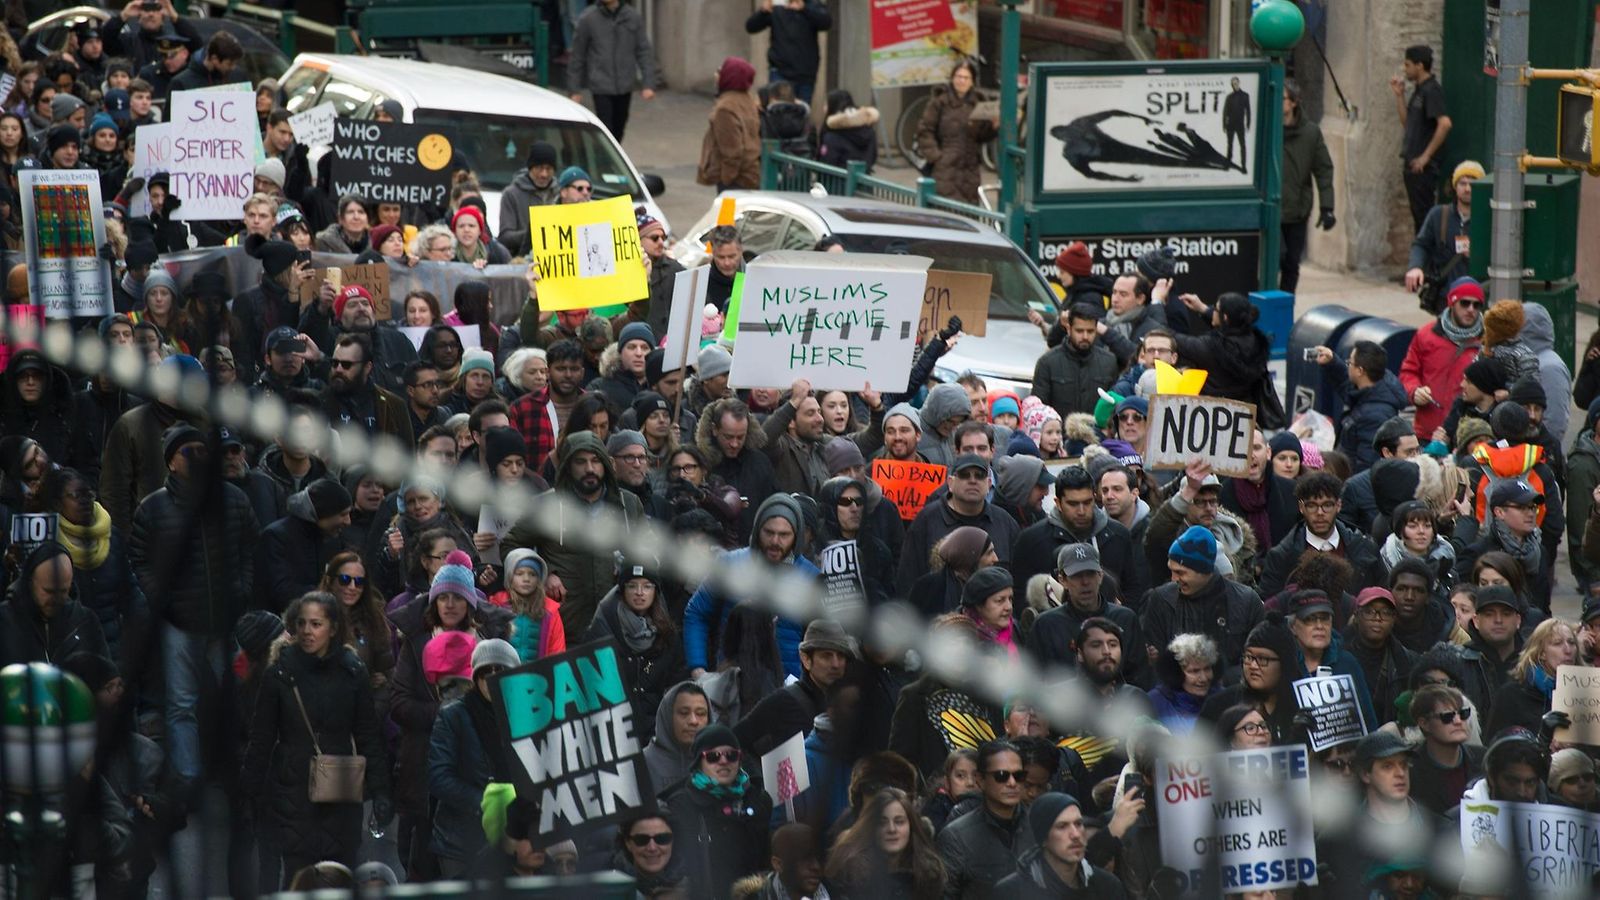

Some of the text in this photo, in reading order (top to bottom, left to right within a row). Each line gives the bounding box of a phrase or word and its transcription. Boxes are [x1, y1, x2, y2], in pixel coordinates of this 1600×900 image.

[188, 101, 236, 122] SIC
[1147, 90, 1223, 115] SPLIT
[338, 122, 380, 141] WHO
[174, 137, 244, 163] SEMPER
[335, 144, 416, 164] WATCHES
[369, 165, 392, 177] the
[170, 171, 252, 199] TYRANNIS
[612, 226, 640, 262] HER
[1167, 237, 1239, 257] Station
[537, 253, 575, 279] WITH
[762, 283, 888, 311] MUSLIMS
[764, 308, 890, 337] WELCOME
[790, 342, 867, 369] HERE
[1161, 404, 1253, 460] NOPE
[877, 464, 944, 485] NO BAN
[14, 516, 53, 542] NO!
[823, 545, 855, 575] NO!
[500, 646, 627, 739] BAN
[1299, 678, 1353, 708] NO!
[511, 701, 641, 784] WHITE
[1167, 757, 1201, 782] NO
[1228, 749, 1307, 783] FREE
[538, 759, 642, 835] MEN
[1164, 777, 1213, 804] ONE
[1212, 798, 1262, 820] WHEN
[1193, 829, 1287, 855] OTHERS ARE
